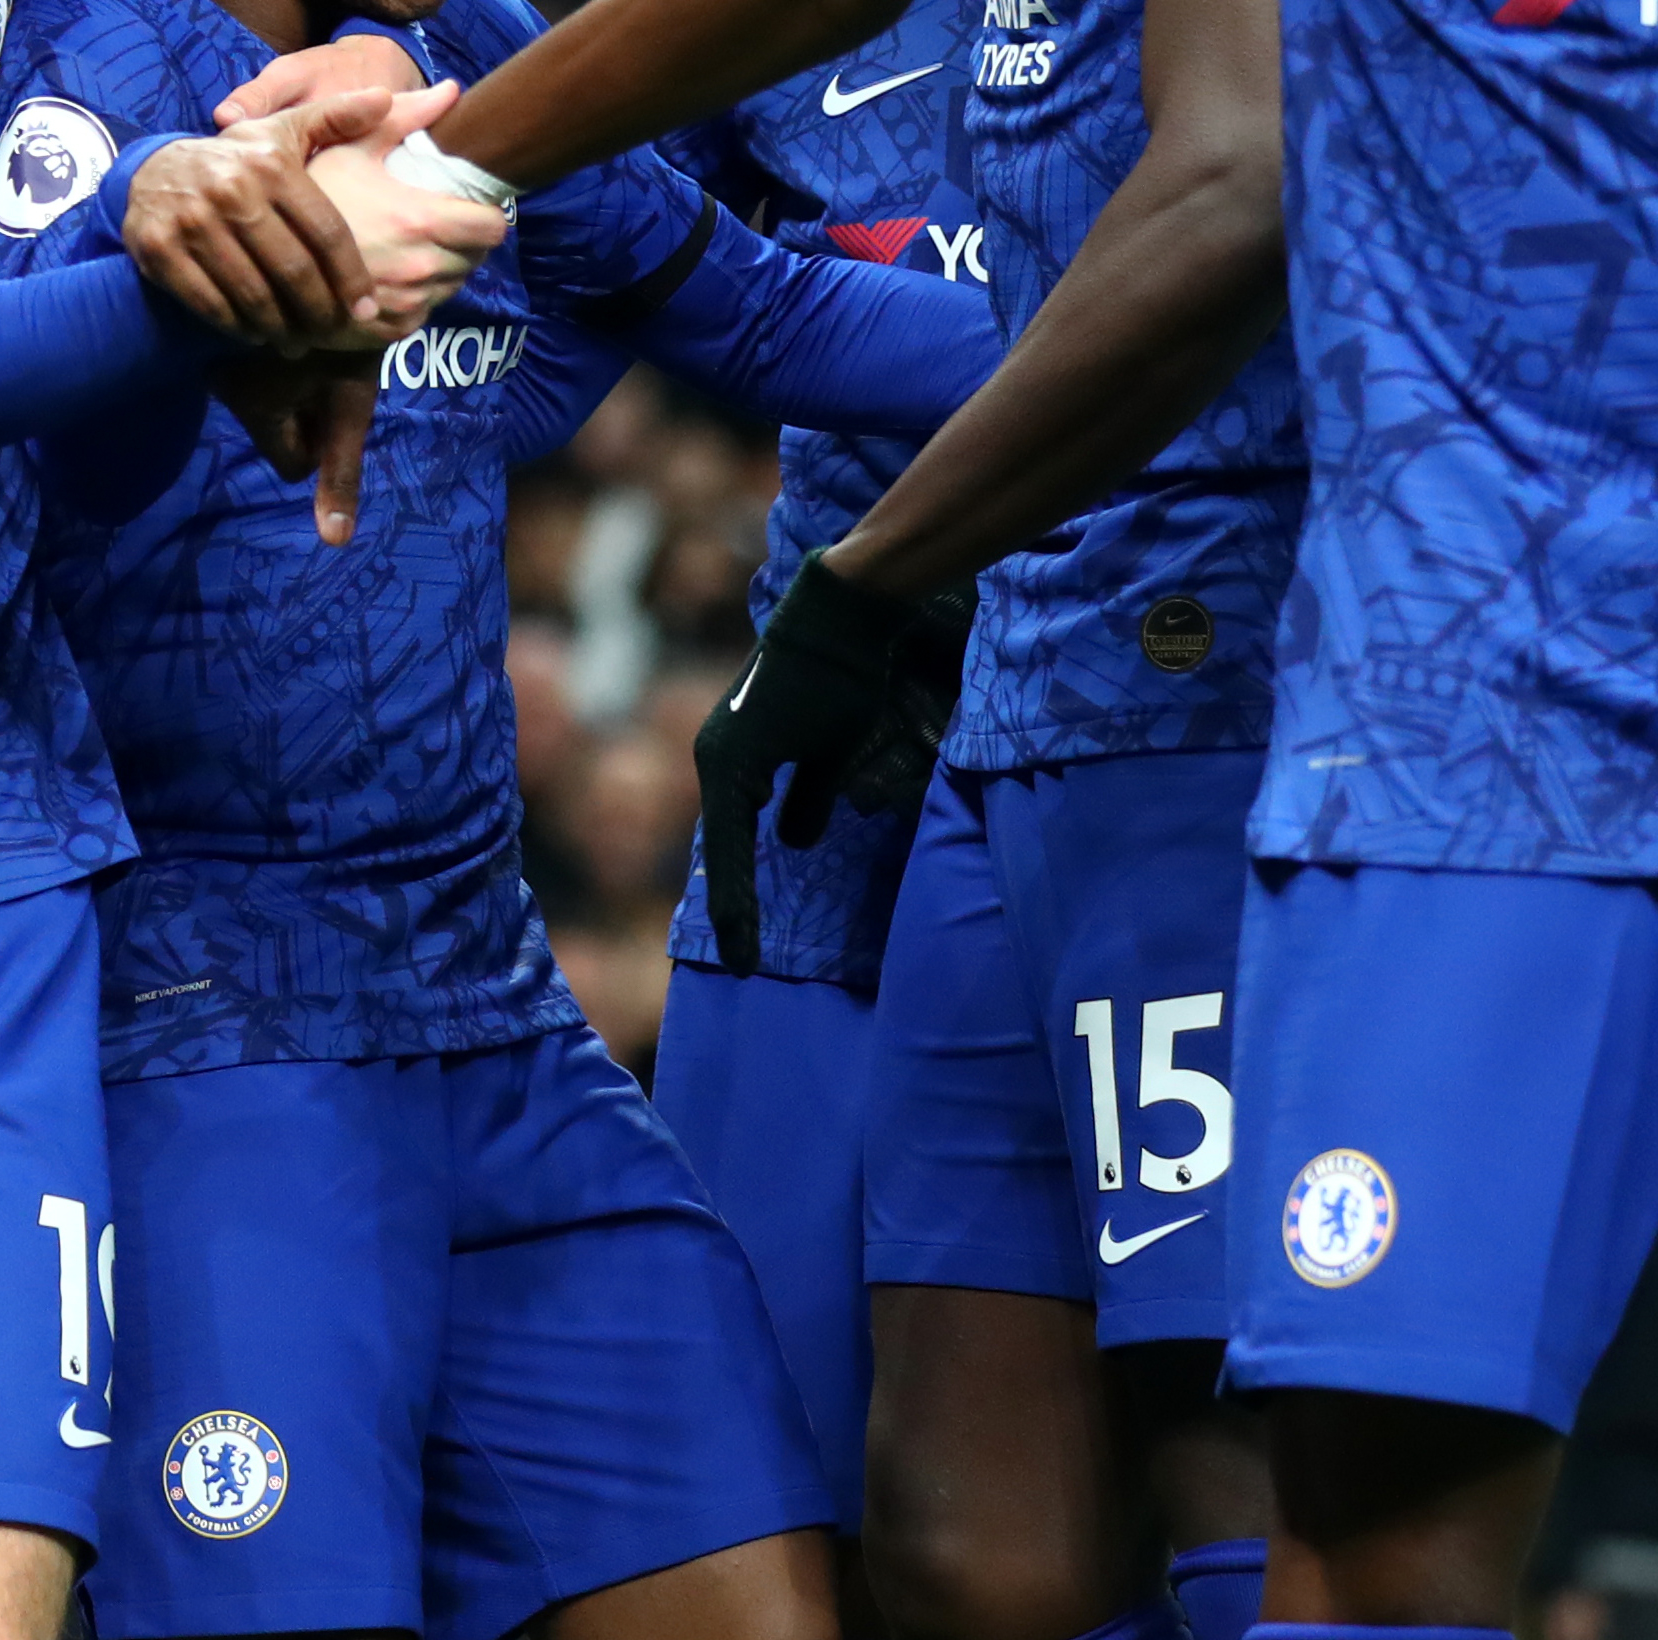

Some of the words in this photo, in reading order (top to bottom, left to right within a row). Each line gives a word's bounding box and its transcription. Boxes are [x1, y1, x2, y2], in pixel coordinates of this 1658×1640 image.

[976, 40, 1056, 87] TYRES
[1074, 991, 1236, 1193] 15
[181, 1415, 260, 1447] CHELSEA
[186, 1512, 241, 1533] FOOTBALL
[243, 1503, 269, 1526] CLUB
